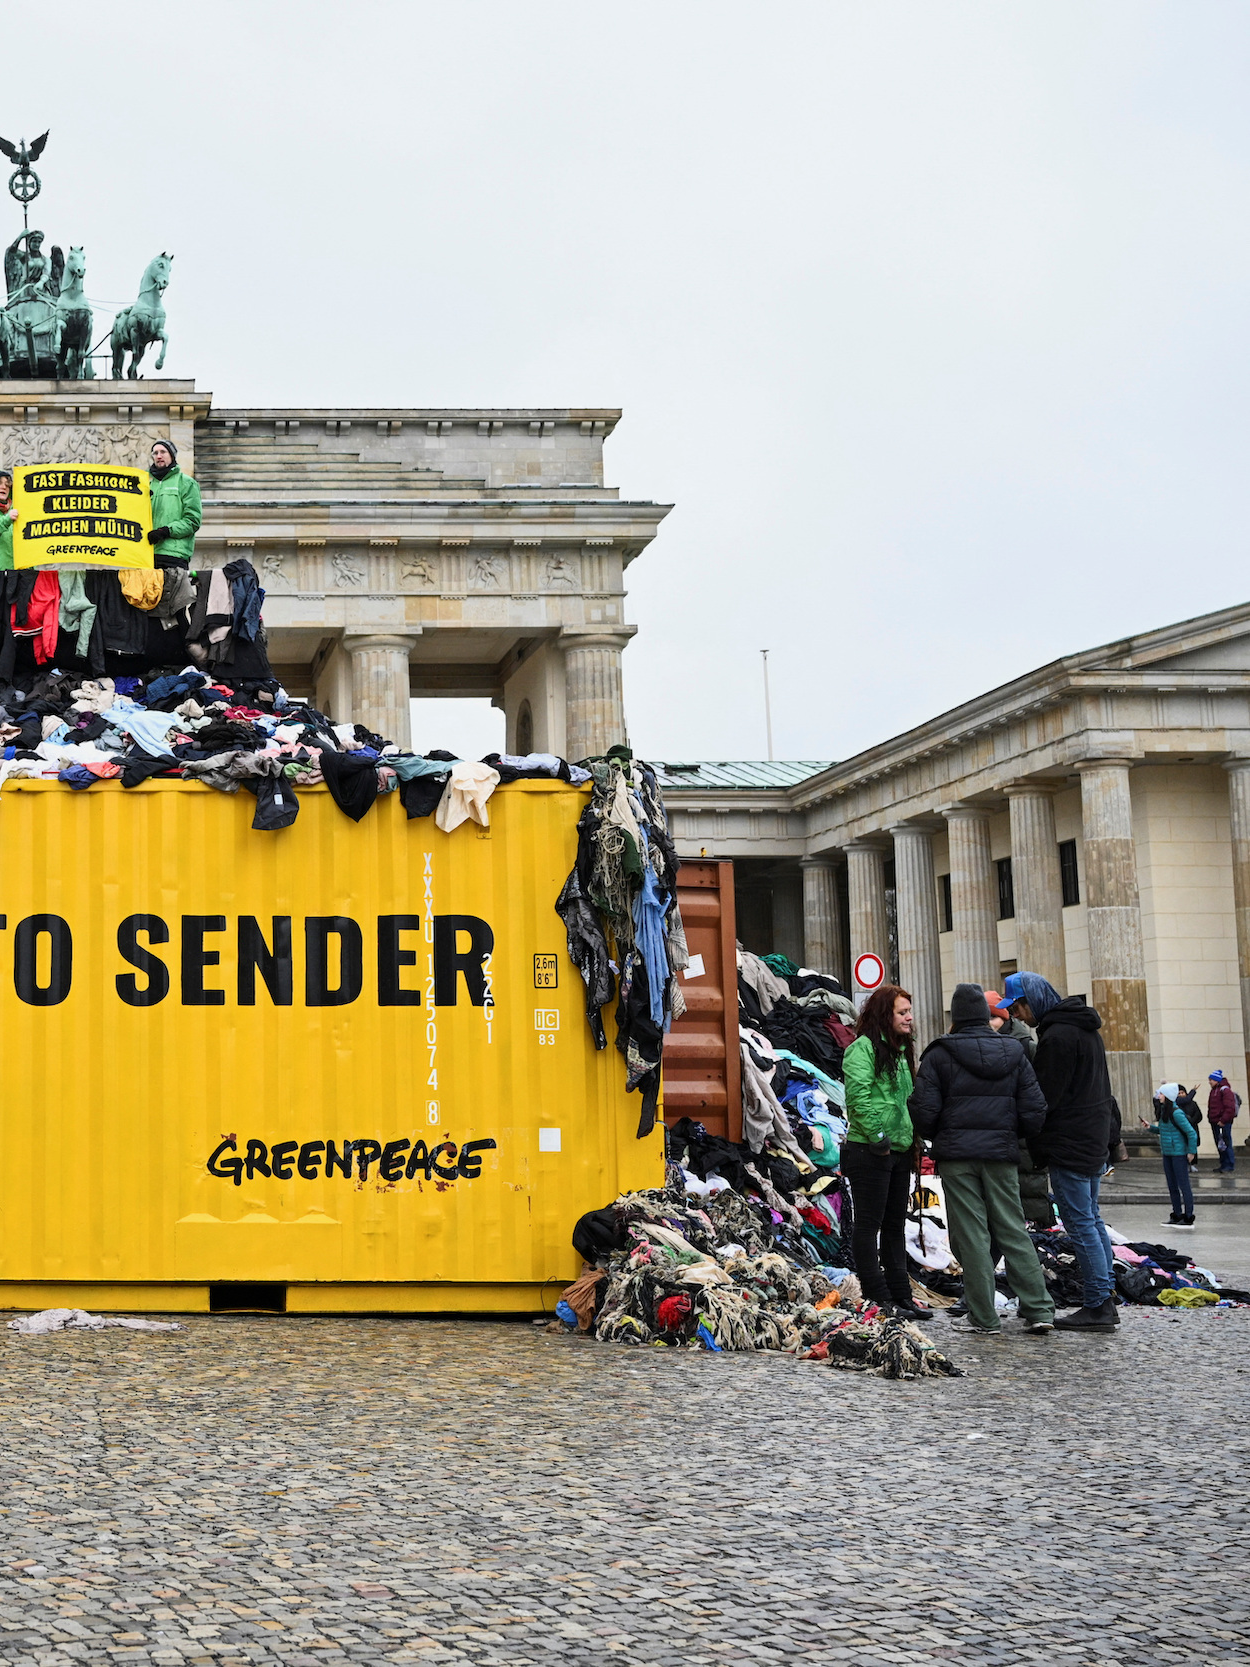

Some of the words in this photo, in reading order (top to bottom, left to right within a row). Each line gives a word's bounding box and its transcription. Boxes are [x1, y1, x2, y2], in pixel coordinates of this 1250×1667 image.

[32, 472, 65, 489] FAST
[69, 472, 133, 490] FASHION:
[52, 496, 110, 511] KLEIDER
[30, 520, 89, 537] MACHEN
[94, 518, 135, 539] MÜLL!
[46, 544, 119, 557] GREENPEACE
[115, 913, 495, 1007] SENDER
[428, 1102, 439, 1124] 8
[206, 1138, 497, 1186] GREENPEACE
